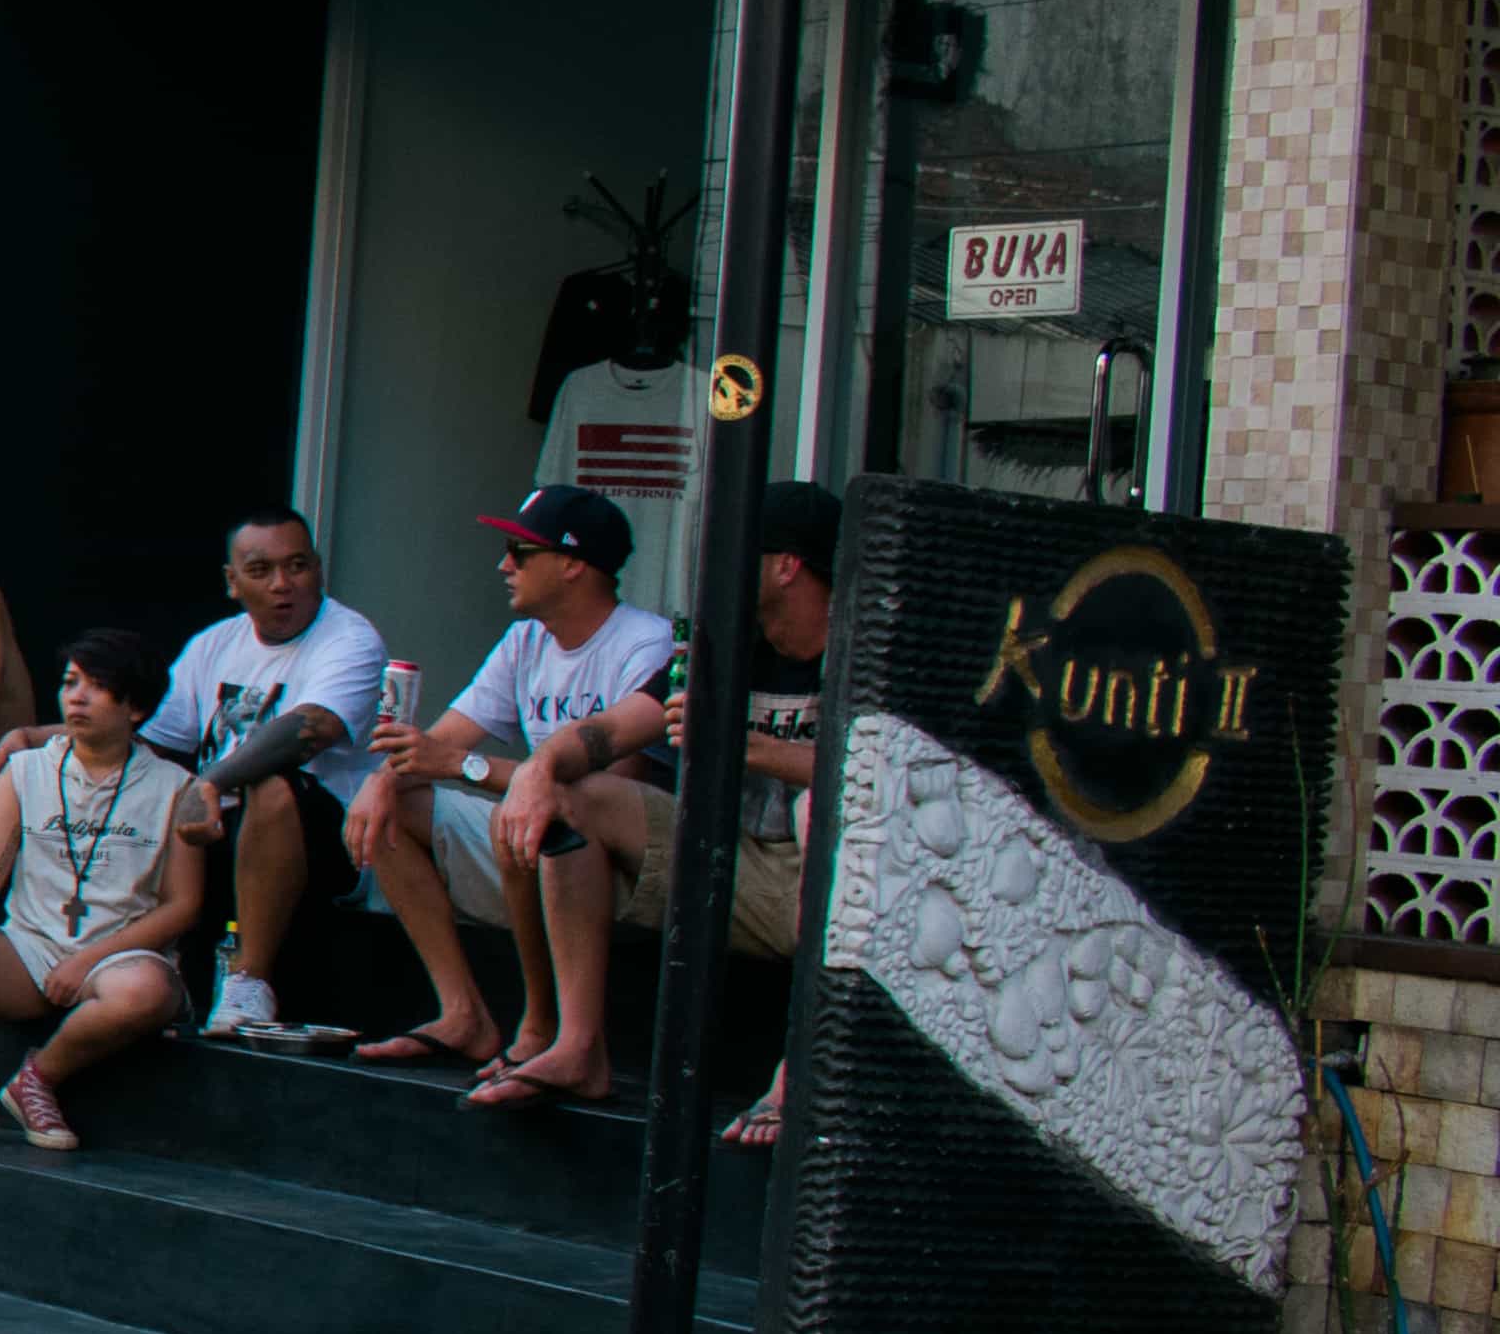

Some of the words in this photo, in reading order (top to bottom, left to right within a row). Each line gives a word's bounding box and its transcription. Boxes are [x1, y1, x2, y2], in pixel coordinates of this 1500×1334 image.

[964, 233, 1067, 279] BUKA
[989, 287, 1037, 307] OPEN
[588, 487, 685, 502] ALIFORNIA
[975, 596, 1190, 737] Kunti
